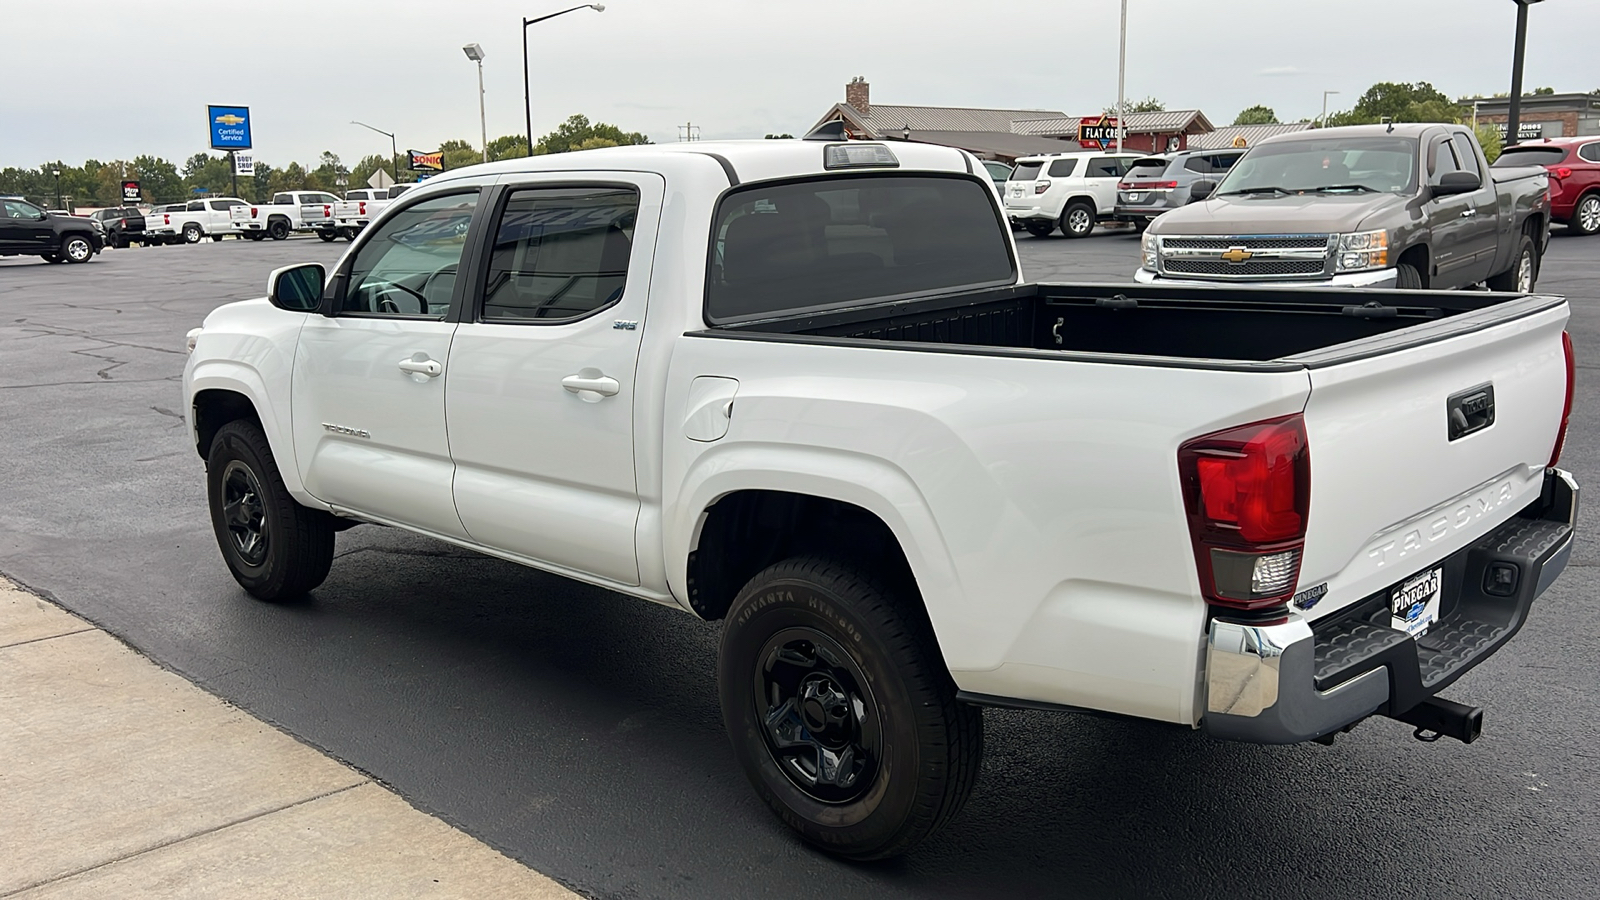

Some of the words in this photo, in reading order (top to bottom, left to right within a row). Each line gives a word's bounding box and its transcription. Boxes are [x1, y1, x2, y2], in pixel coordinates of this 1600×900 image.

[218, 128, 244, 136] Certified
[1085, 127, 1104, 138] FLAT
[1105, 127, 1127, 139] CREK
[1518, 122, 1541, 131] Jones
[413, 155, 441, 165] SONIC
[321, 422, 371, 439] TACOMA
[1368, 481, 1512, 567] TACOMA
[1294, 582, 1328, 604] PINEGAR
[1393, 576, 1438, 613] PINEGAR
[738, 590, 795, 626] ADVANTA
